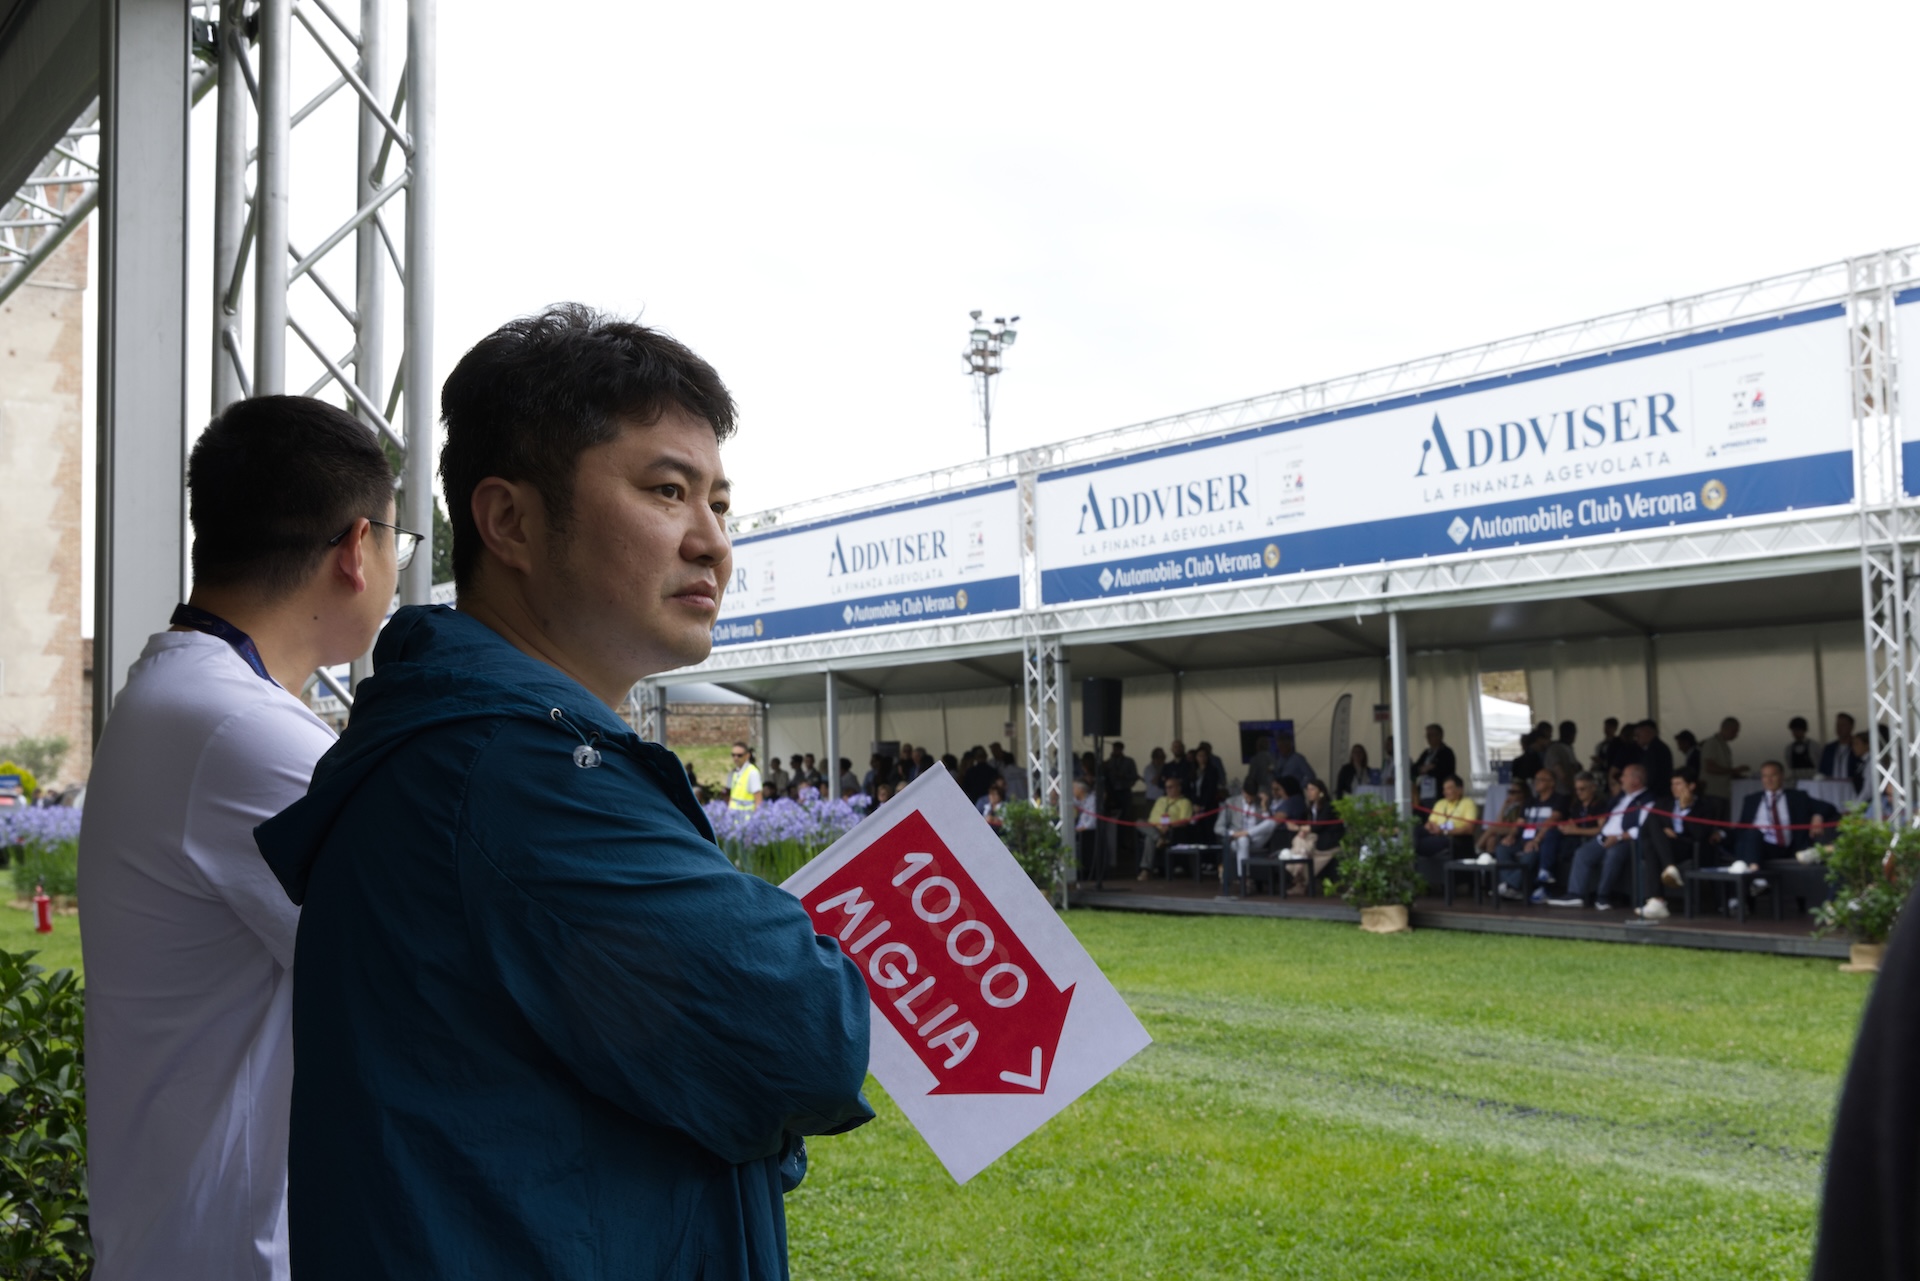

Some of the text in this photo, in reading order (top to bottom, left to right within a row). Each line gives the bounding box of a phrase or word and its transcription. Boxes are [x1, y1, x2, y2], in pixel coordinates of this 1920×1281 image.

[1415, 392, 1681, 477] ADDVISER
[1423, 451, 1670, 504] LA FINANZA AGEVOLATA
[1076, 473, 1250, 534] ADDVISER
[1470, 491, 1696, 541] Automobile Club Verona
[828, 530, 947, 577] ADDVISER
[1082, 521, 1244, 556] LA FINANZA AGEVOLATA
[1114, 551, 1261, 588] Automobile Club Verona
[853, 594, 955, 622] Automobile Club Verona
[892, 852, 1028, 1009] 1000
[816, 886, 979, 1069] MIGLIA
